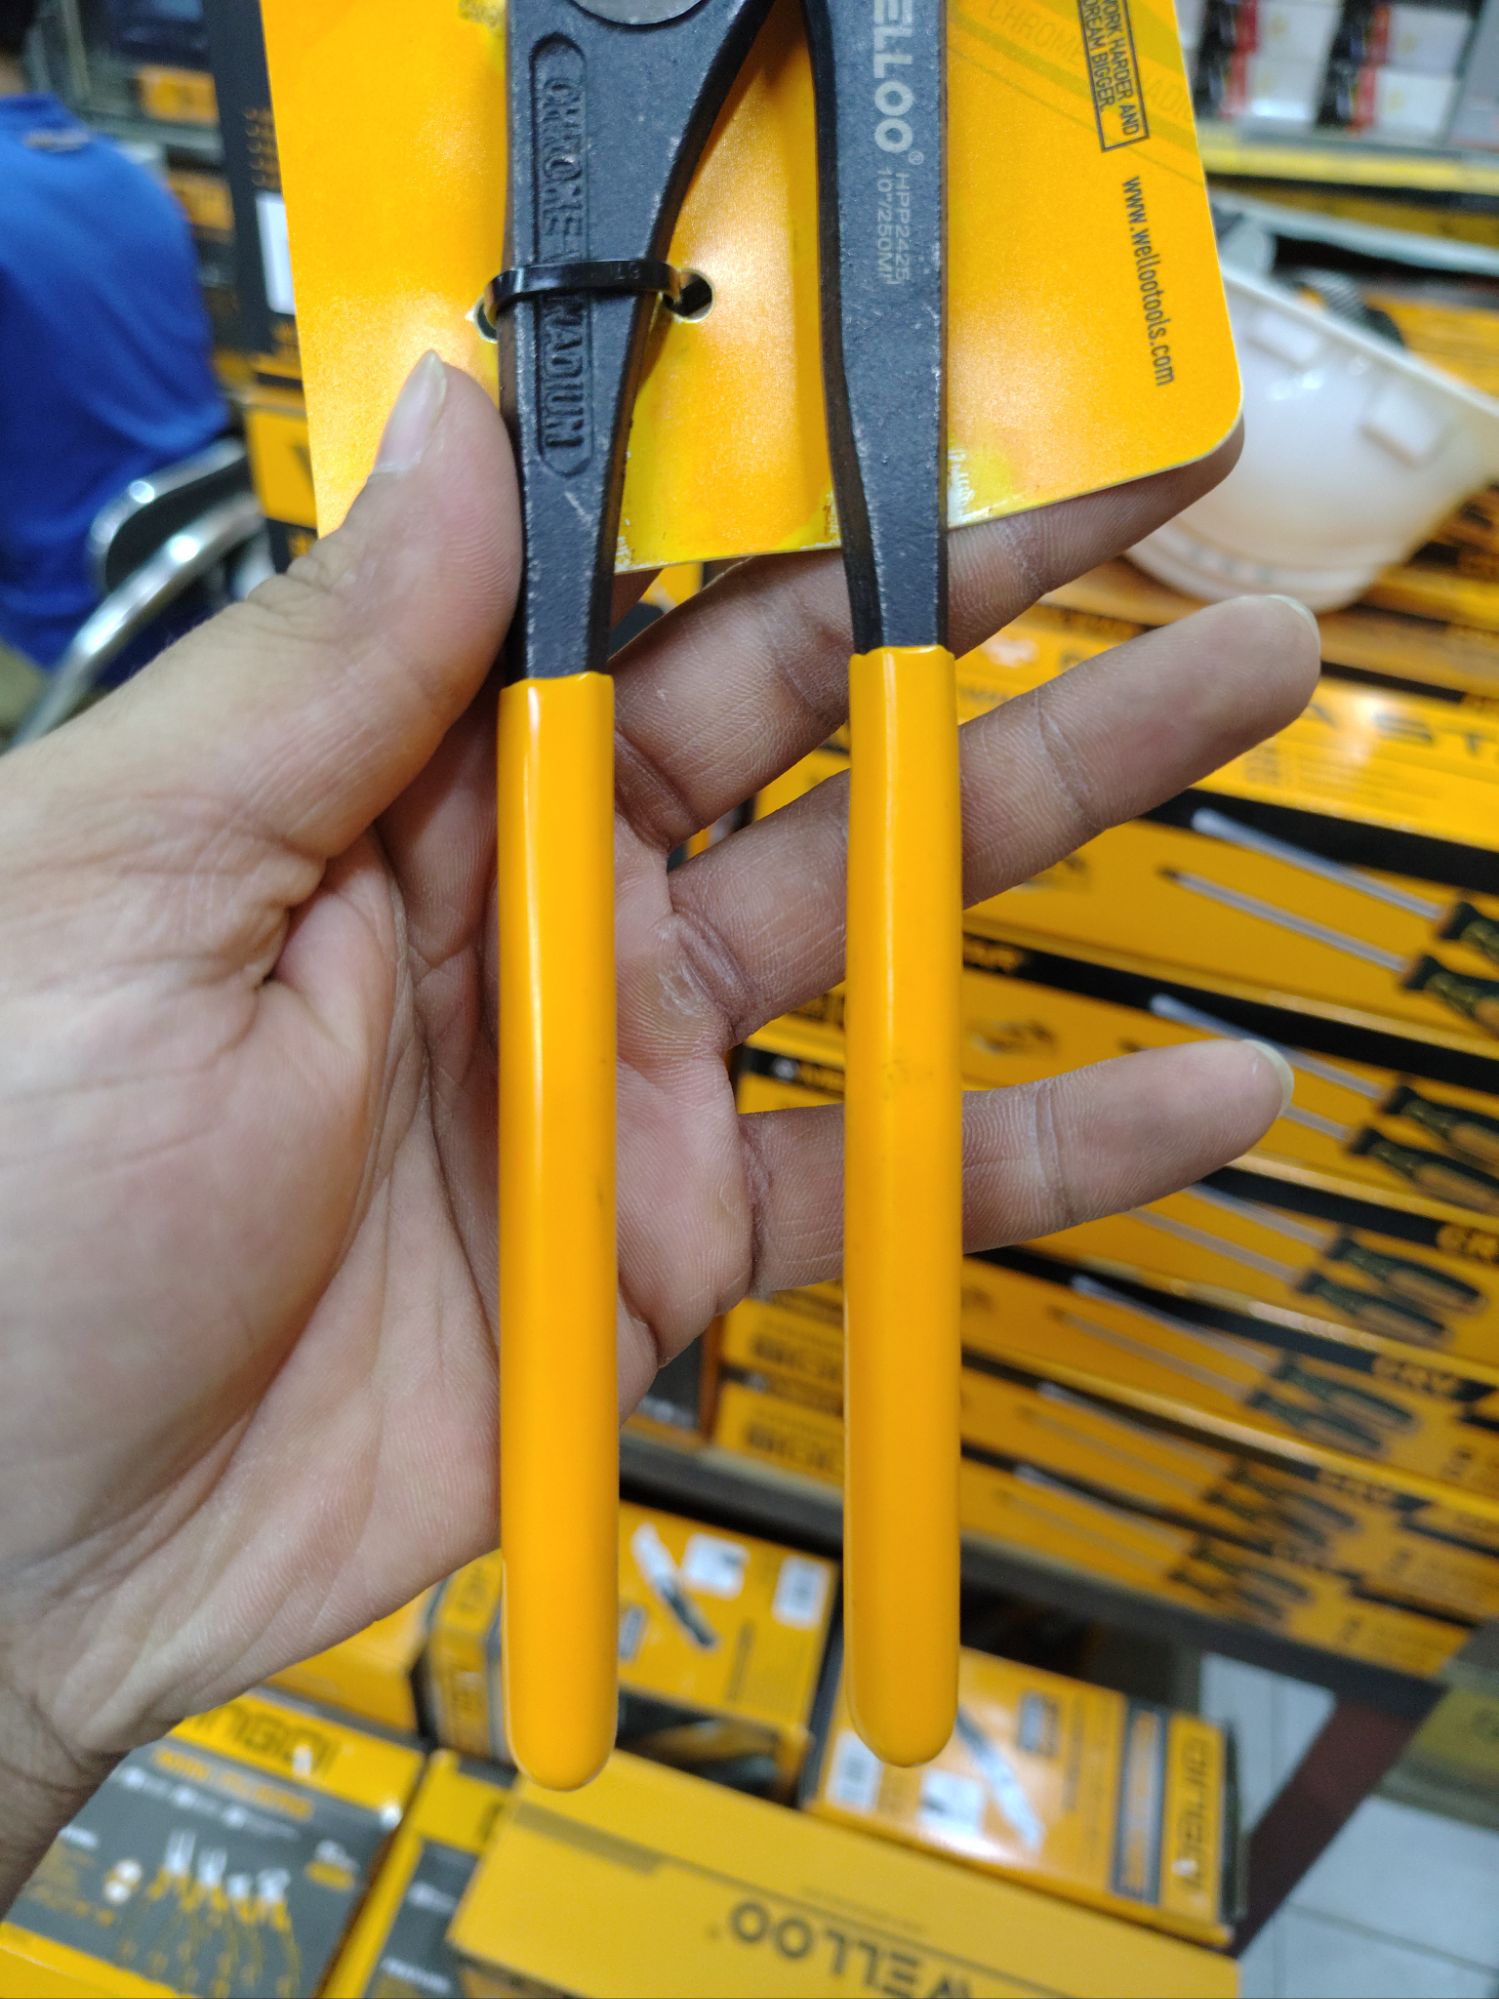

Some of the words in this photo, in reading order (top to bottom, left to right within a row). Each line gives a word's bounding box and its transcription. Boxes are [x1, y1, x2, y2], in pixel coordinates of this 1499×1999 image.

[1109, 37, 1134, 101] HARDER
[1119, 104, 1140, 136] AND
[895, 171, 911, 281] HPP2425
[1122, 175, 1175, 387] www.wellootools.com
